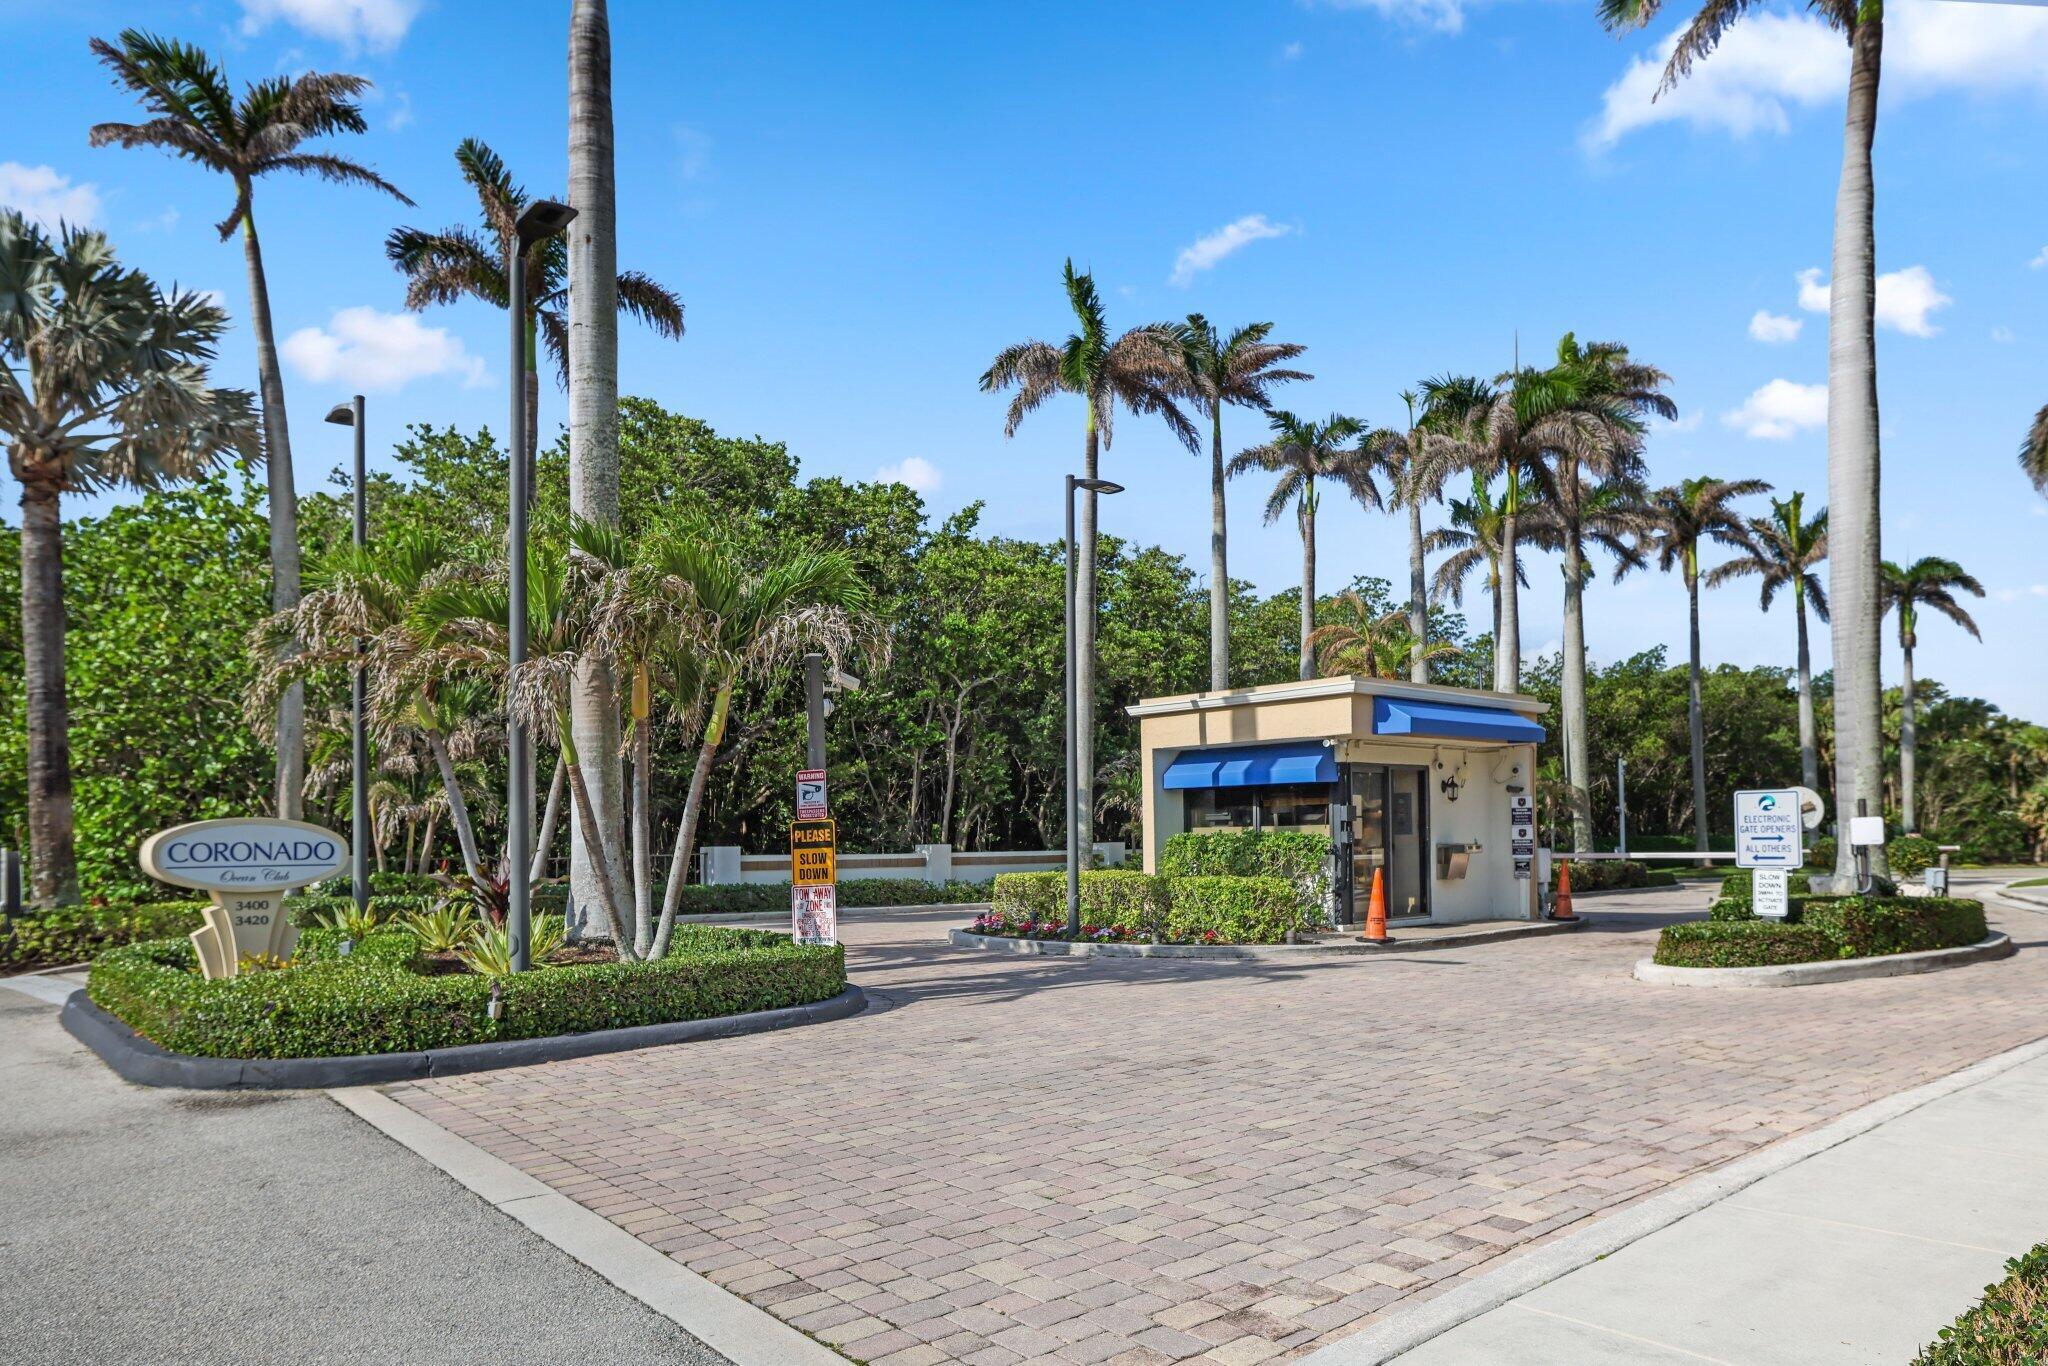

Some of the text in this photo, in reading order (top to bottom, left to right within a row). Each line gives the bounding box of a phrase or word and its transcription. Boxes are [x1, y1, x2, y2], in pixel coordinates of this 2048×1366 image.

[798, 772, 824, 780] WARNING
[1744, 815, 1791, 823] ELECTRONIC
[1740, 825, 1796, 833] GATE OPENERS
[794, 829, 831, 842] PLEASE
[167, 841, 335, 863] CORONADO
[1745, 844, 1792, 853] ALL OTHERS
[800, 853, 827, 865] SLOW
[220, 868, 290, 883] Ocean Club
[800, 868, 829, 880] DOWN
[235, 900, 269, 911] 3400
[805, 900, 823, 911] ZONE
[235, 915, 269, 926] 3420
